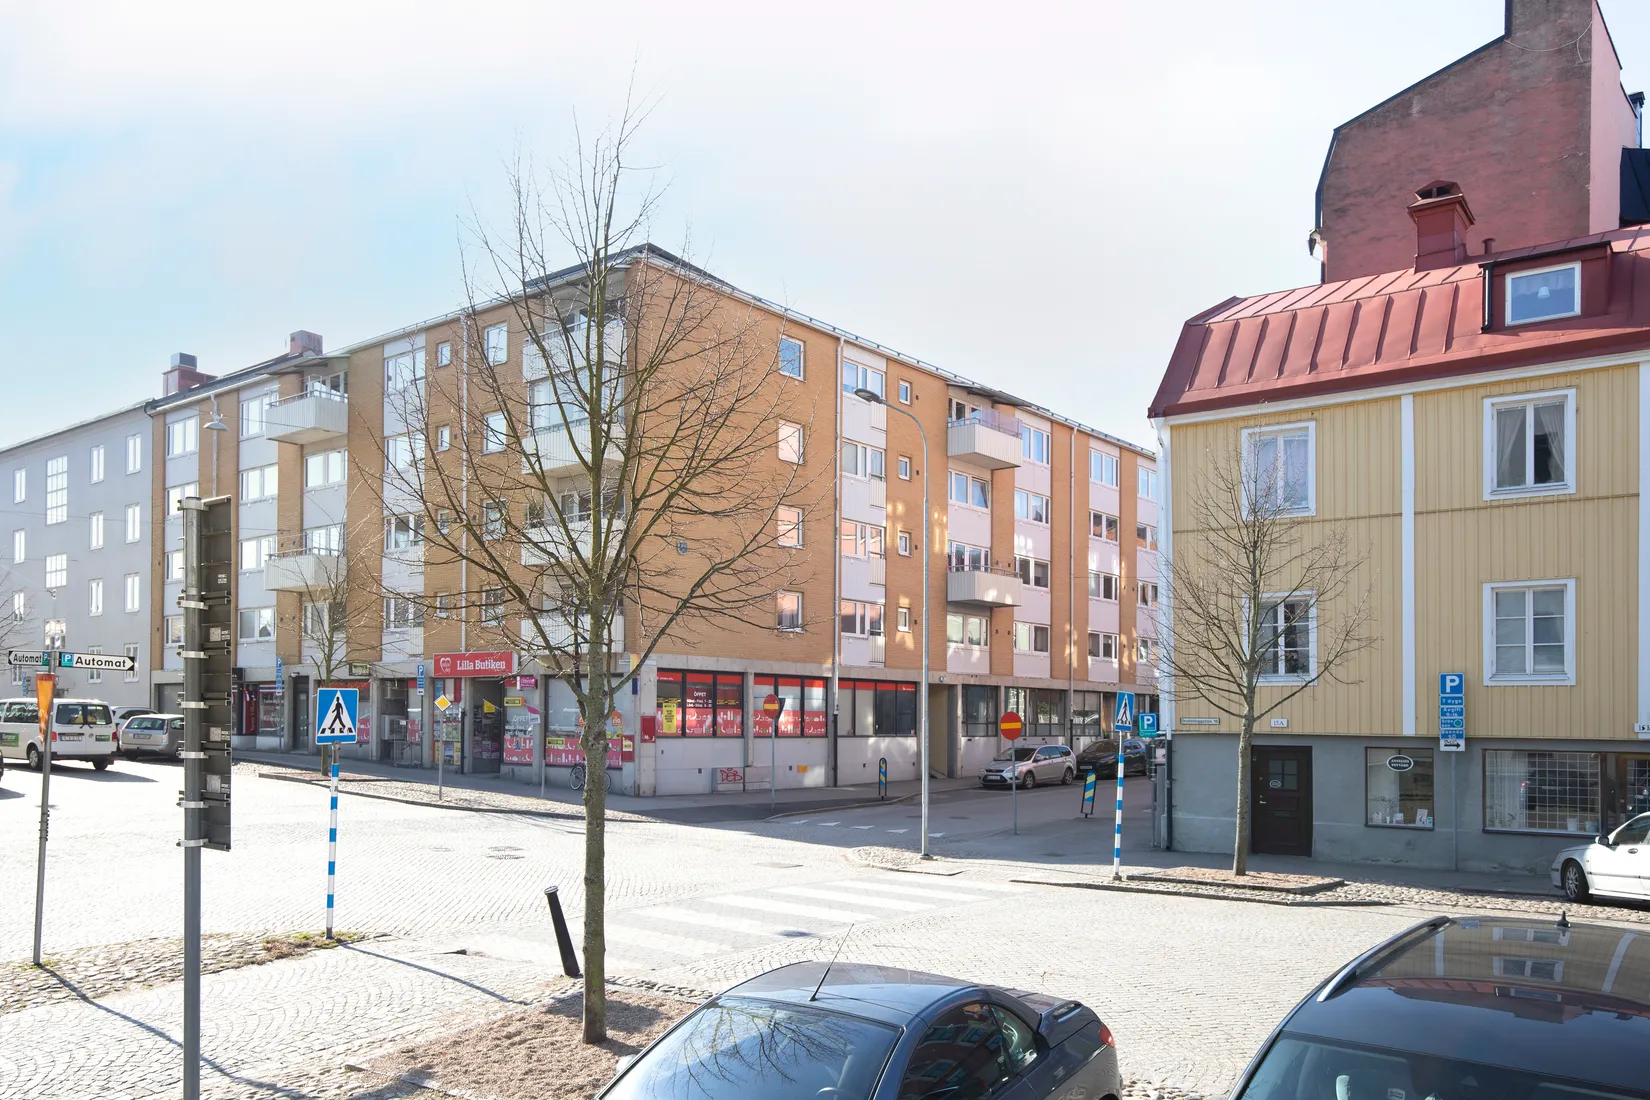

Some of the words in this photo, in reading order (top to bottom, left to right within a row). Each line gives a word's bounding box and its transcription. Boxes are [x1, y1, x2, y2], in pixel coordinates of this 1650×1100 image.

[13, 654, 42, 663] Automat
[64, 654, 72, 662] P
[75, 656, 126, 668] Automat
[456, 660, 474, 670] Lilla
[475, 659, 506, 670] Butiken
[1445, 675, 1460, 693] P
[1143, 715, 1153, 729] P
